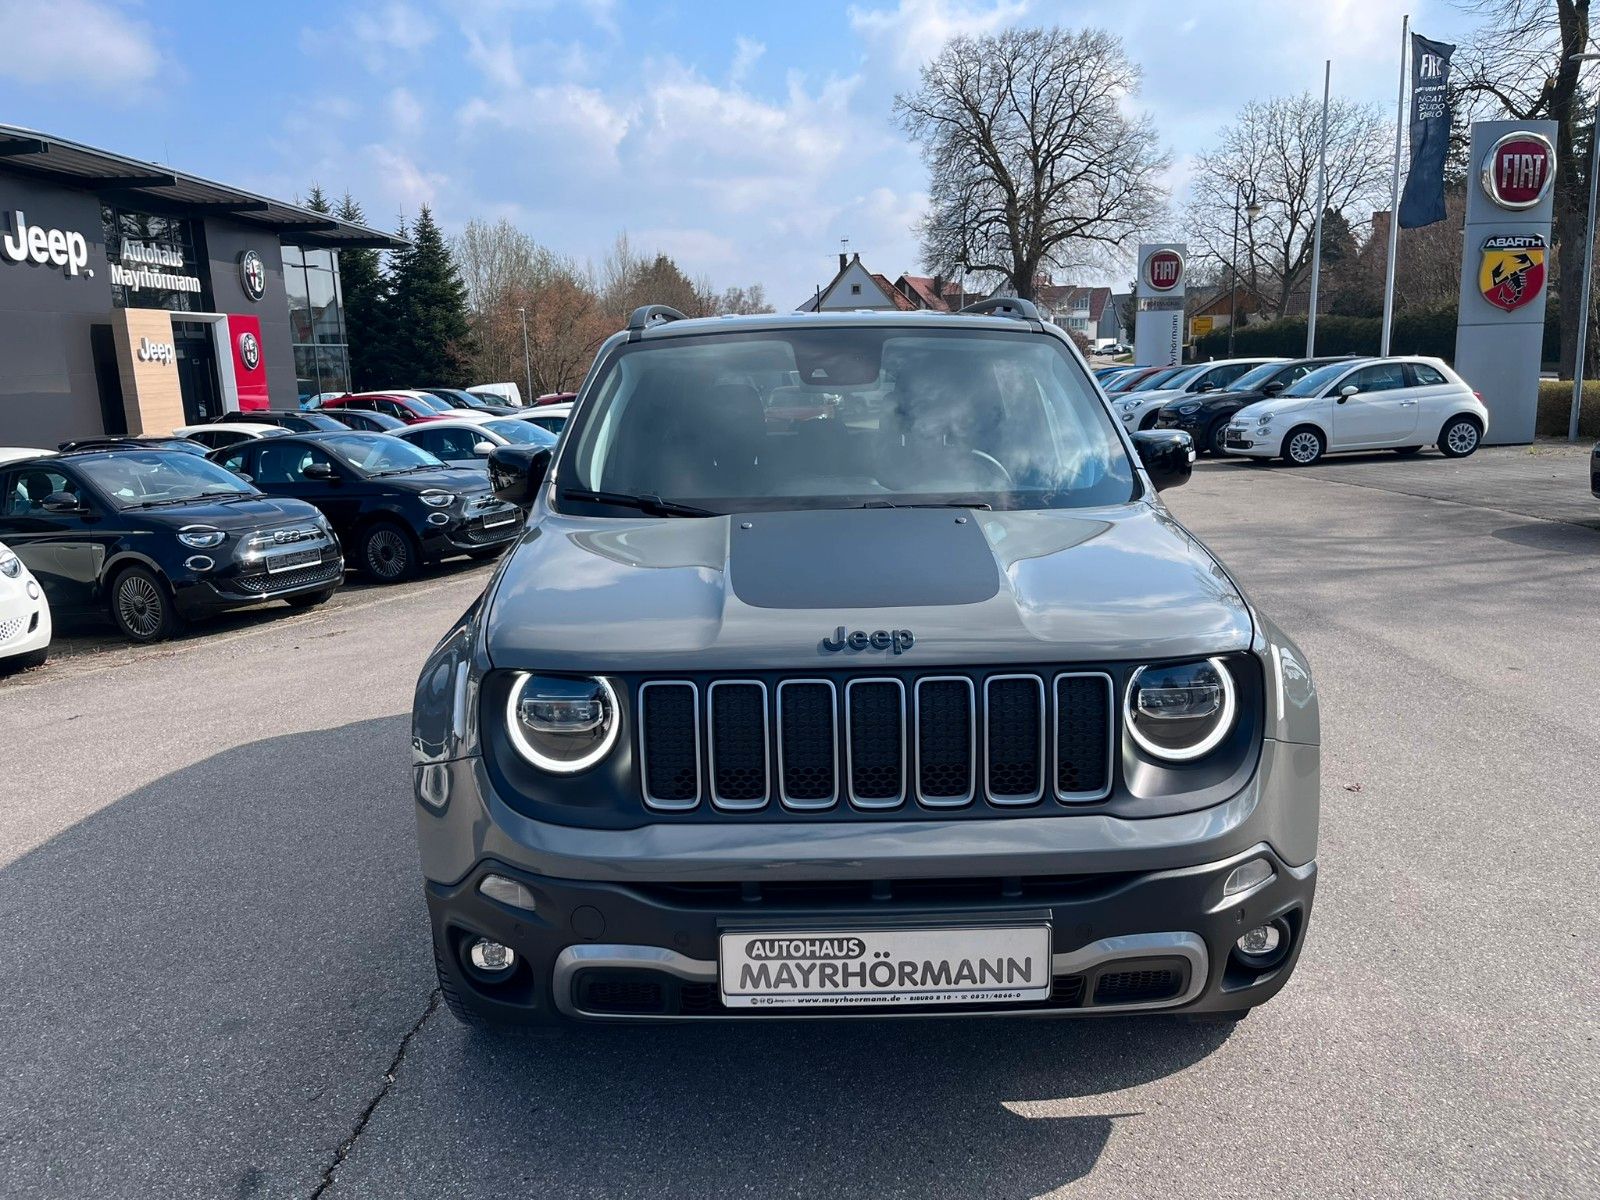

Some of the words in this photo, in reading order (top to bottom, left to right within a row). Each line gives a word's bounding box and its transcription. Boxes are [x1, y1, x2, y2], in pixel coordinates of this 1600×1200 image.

[1501, 153, 1545, 189] FIAT
[4, 210, 88, 276] Jeep
[123, 240, 184, 268] Autohaus
[1486, 237, 1542, 247] ABARTH
[110, 263, 201, 293] Mayrhörmann
[1153, 261, 1179, 280] FIAT
[140, 337, 173, 362] Jeep
[823, 626, 915, 655] Jeep
[751, 938, 860, 958] AUTOHAUS
[739, 951, 1032, 990] MAYRHÖRMANN
[797, 995, 901, 1004] www.mayrhoermann.de
